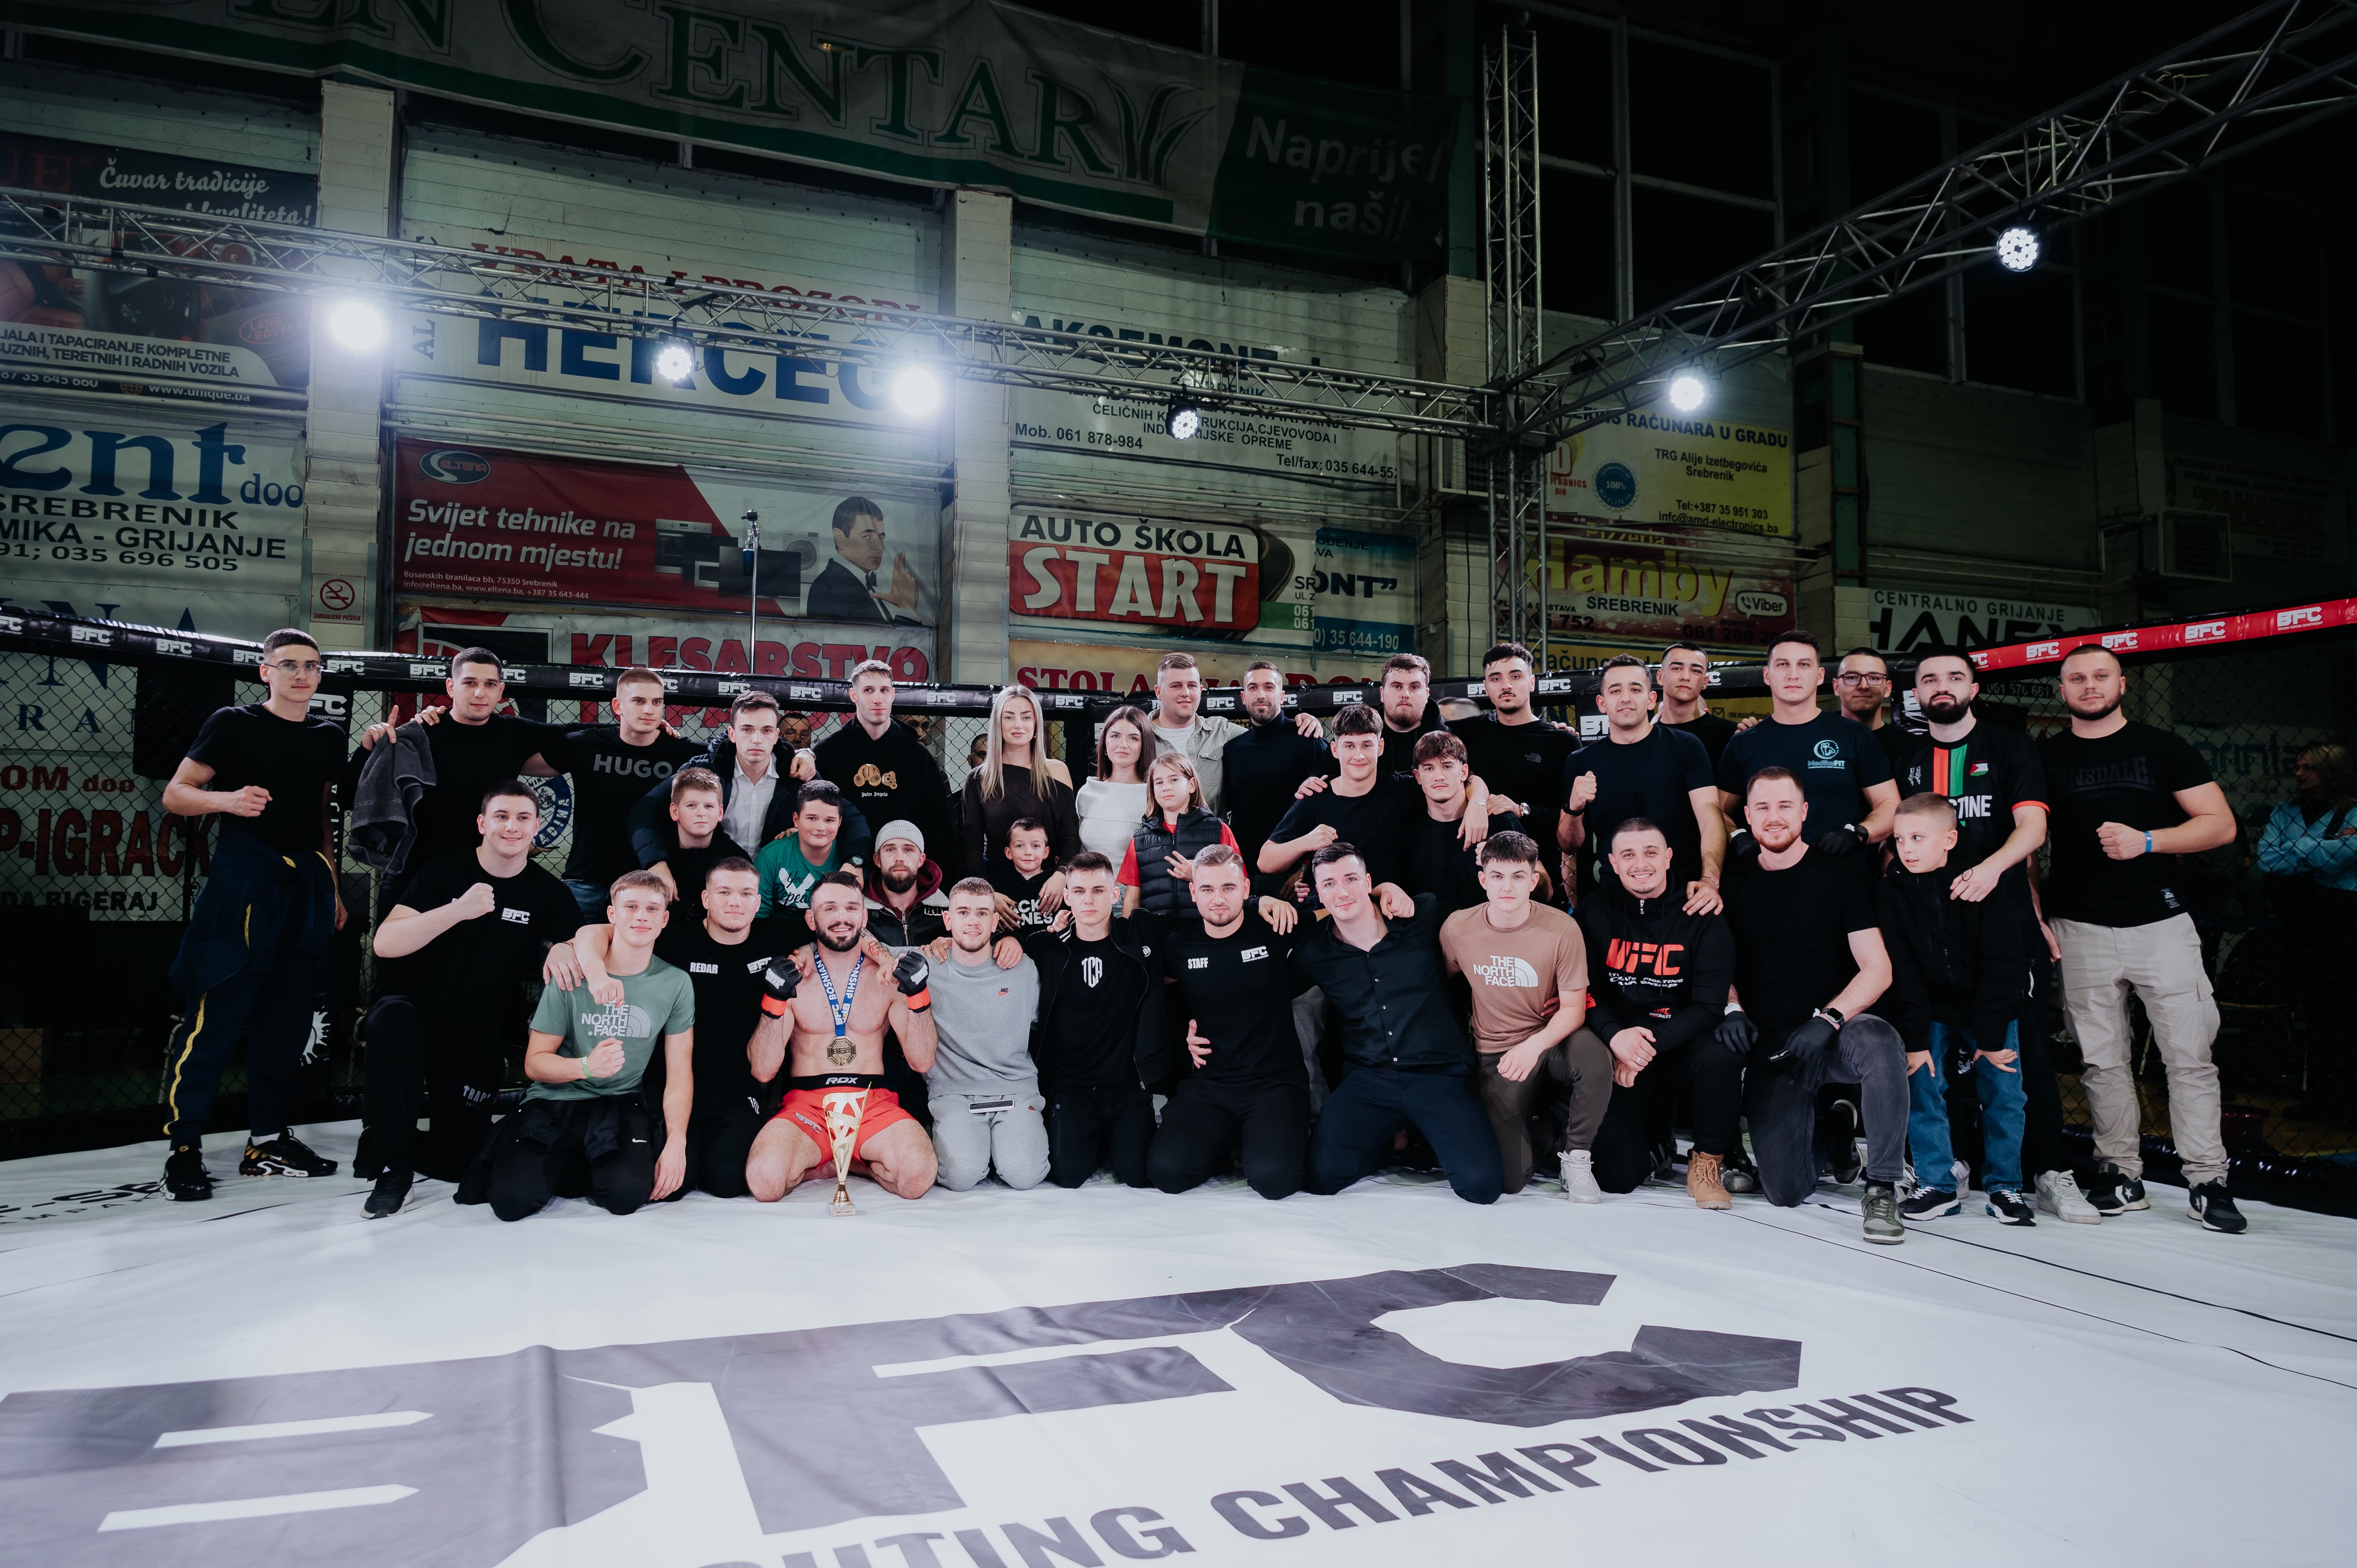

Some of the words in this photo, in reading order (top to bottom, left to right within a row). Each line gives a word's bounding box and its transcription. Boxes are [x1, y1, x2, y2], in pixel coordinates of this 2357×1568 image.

[99, 158, 171, 189] Čuvar
[175, 171, 269, 200] tradicije
[1294, 190, 1412, 242] naši!
[48, 333, 144, 354] TAPACIRANJE
[147, 344, 231, 364] KOMPLETNE
[0, 343, 50, 360] UZNIH,
[53, 348, 122, 366] TERETNIH
[132, 356, 186, 372] RADNIH
[189, 362, 240, 378] VOZILA
[1092, 401, 1153, 420] ČELIČNIH
[1015, 422, 1051, 439] Mob.
[1057, 427, 1081, 442] 061
[1087, 431, 1143, 449] 878-984
[1626, 412, 1715, 438] RAČUNARA
[1720, 426, 1730, 440] U
[1736, 428, 1788, 448] GRADU
[1242, 435, 1292, 450] OPREME
[1277, 453, 1323, 471] Tel/fax:
[1325, 459, 1348, 473] 035
[1655, 448, 1678, 461] TRG
[1680, 452, 1703, 466] Alije
[1706, 455, 1768, 473] Izetbegovića
[1686, 465, 1735, 482] Srebrenik
[240, 473, 304, 508] doo
[1606, 480, 1626, 490] 100%
[0, 493, 239, 530] REBRENIK
[1676, 499, 1717, 513] Tel:+387
[1719, 505, 1730, 515] 35
[1733, 506, 1748, 517] 951
[1752, 508, 1768, 520] 303
[408, 499, 489, 532] Svijet
[497, 507, 595, 535] tehnike
[603, 521, 636, 540] na
[115, 527, 286, 560] GRIJANJE
[1020, 515, 1121, 547] AUTO
[1134, 517, 1246, 559] ŠKOLA
[51, 546, 109, 563] 035
[118, 551, 174, 567] 696
[185, 556, 239, 572] 505
[405, 532, 512, 562] jednom
[519, 543, 623, 572] mjestu!
[404, 570, 443, 581] Bosanskih
[445, 572, 481, 583] branilaca
[482, 575, 495, 584] bb,
[497, 577, 521, 586] 75350
[522, 578, 558, 588] Srebrenik
[1525, 534, 1734, 617] Hamby
[403, 580, 464, 592] info@eltena.ba,
[466, 584, 525, 596] www.eltena.ba,
[527, 588, 546, 597] +387
[548, 589, 557, 598] 35
[558, 590, 589, 599] 643-444
[1022, 546, 1248, 624] START
[1587, 596, 1679, 616] SREBRENIK
[1753, 597, 1782, 613] Viber
[1874, 589, 1978, 614] CENTRALNO
[1987, 599, 2065, 623] GRIJANJE
[1560, 614, 1595, 631] 752
[2277, 607, 2323, 627] BFC
[71, 626, 111, 644] BFC
[1330, 629, 1346, 645] 35
[1349, 631, 1399, 650] 644-190
[1683, 624, 1713, 640] 061
[1723, 627, 1753, 642] 280
[2185, 621, 2226, 640] BFC
[157, 639, 193, 655] BFC
[2026, 642, 2060, 658] BFC
[2101, 633, 2138, 649] BFC
[327, 660, 365, 673] BFC
[410, 663, 447, 676] BFC
[501, 668, 527, 680] FC
[569, 672, 604, 685] BFC
[718, 681, 751, 693] BFC
[1539, 679, 1571, 691] BFC
[790, 685, 822, 698] BFC
[927, 692, 956, 703] BFC
[1333, 691, 1363, 703] BFC
[1467, 683, 1486, 695] BF
[307, 693, 348, 716] FC
[1055, 695, 1084, 707] BFC
[1207, 697, 1235, 708] BFC
[593, 754, 673, 780] HUGO
[82, 774, 135, 793] doo
[787, 871, 805, 889] You
[502, 907, 531, 922] BFC
[1241, 946, 1269, 960] BFC
[1490, 954, 1515, 968] THE
[1605, 938, 1684, 976] UFC
[690, 962, 719, 975] REDAR
[1187, 957, 1209, 970] STAFF
[1473, 964, 1515, 977] NORTH
[817, 959, 837, 1001] BOSNIAN
[1485, 975, 1515, 987] FACE
[604, 1003, 630, 1016] THE
[831, 1003, 843, 1026] BFC
[581, 1013, 628, 1026] NORTH
[593, 1025, 627, 1037] FACE
[825, 1076, 859, 1086] RDX
[1208, 1383, 1976, 1542] CHAMPIONSHIP
